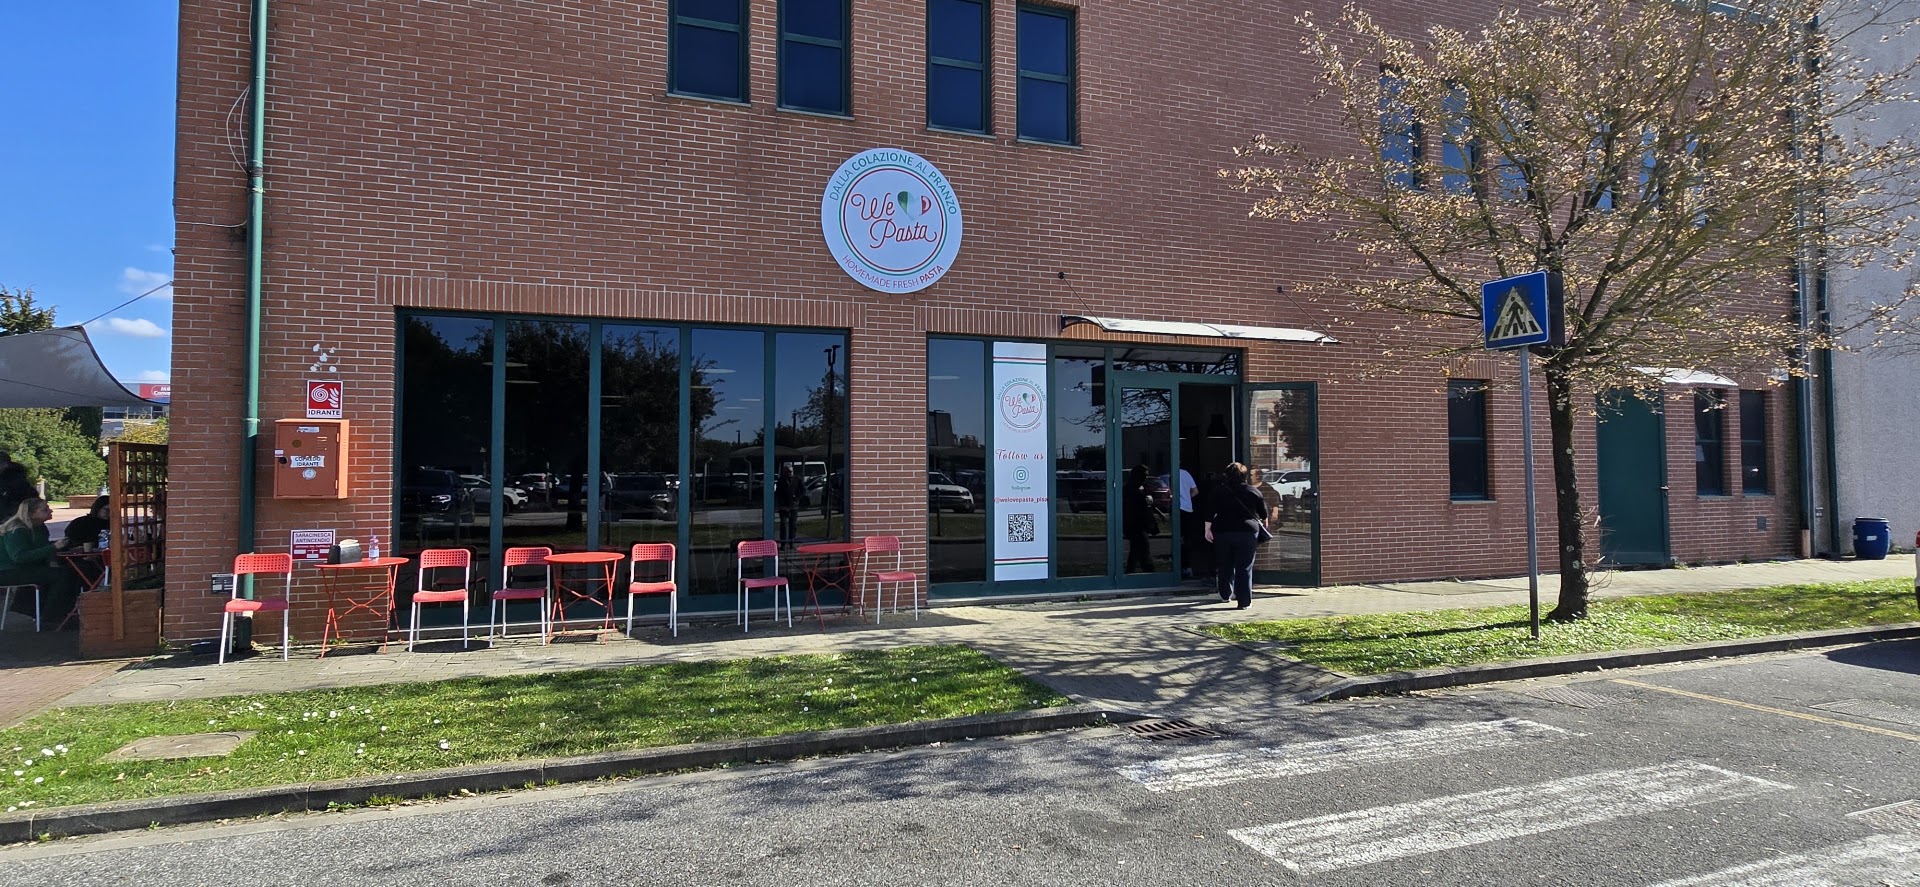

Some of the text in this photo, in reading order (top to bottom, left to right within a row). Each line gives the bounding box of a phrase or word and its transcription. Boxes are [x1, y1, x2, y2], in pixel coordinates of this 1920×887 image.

[829, 152, 957, 215] DALLA COLAZIONE AL PRANZO
[850, 192, 895, 221] We
[869, 218, 937, 249] Pasta
[842, 255, 944, 289] HOMEMADE FRESH PASTA
[1005, 394, 1022, 407] We
[1012, 405, 1040, 419] Pasta
[995, 448, 1028, 460] Follow
